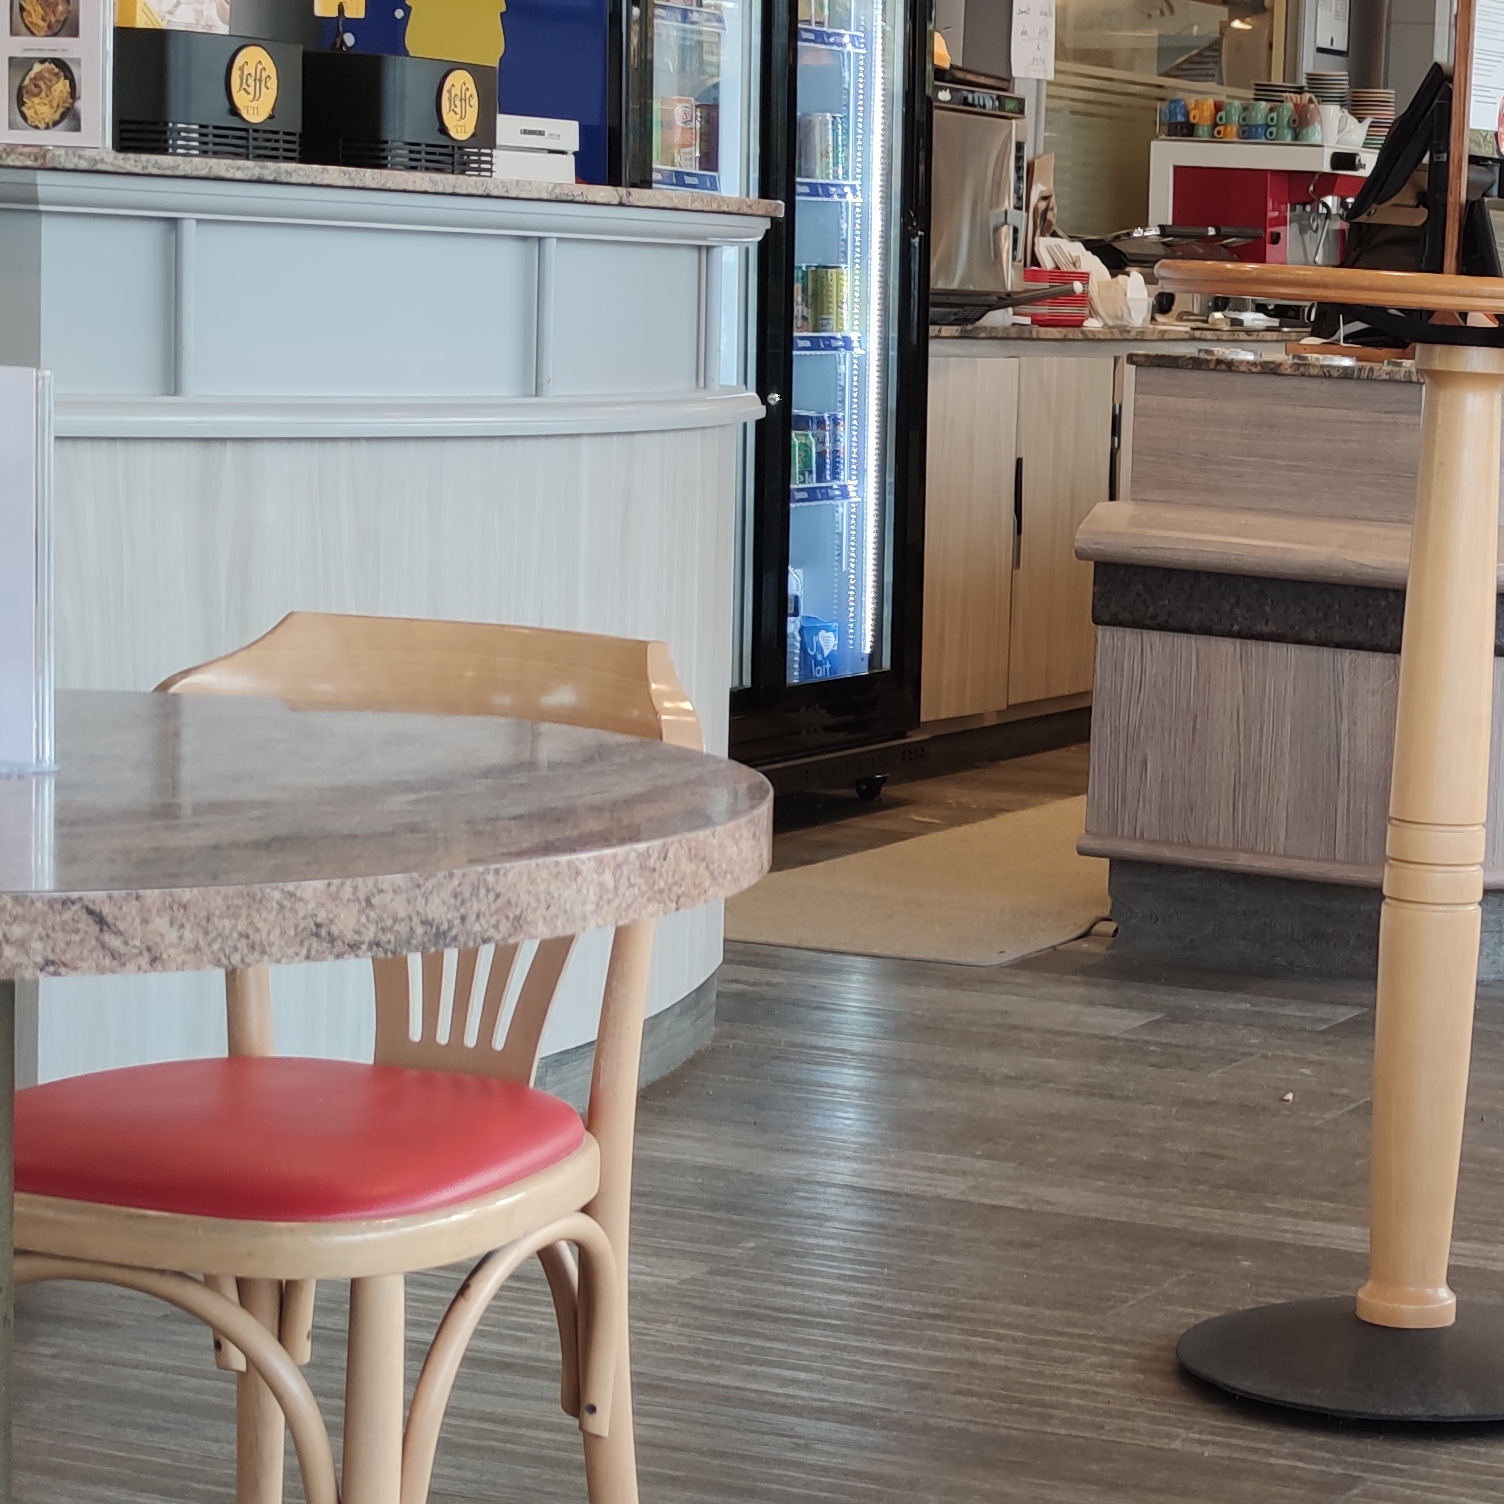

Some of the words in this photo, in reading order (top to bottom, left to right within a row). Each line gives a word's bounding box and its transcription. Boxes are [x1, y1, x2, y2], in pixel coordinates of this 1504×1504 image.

[237, 59, 272, 102] Leffe
[447, 81, 475, 121] Leffe
[811, 659, 832, 677] lait
